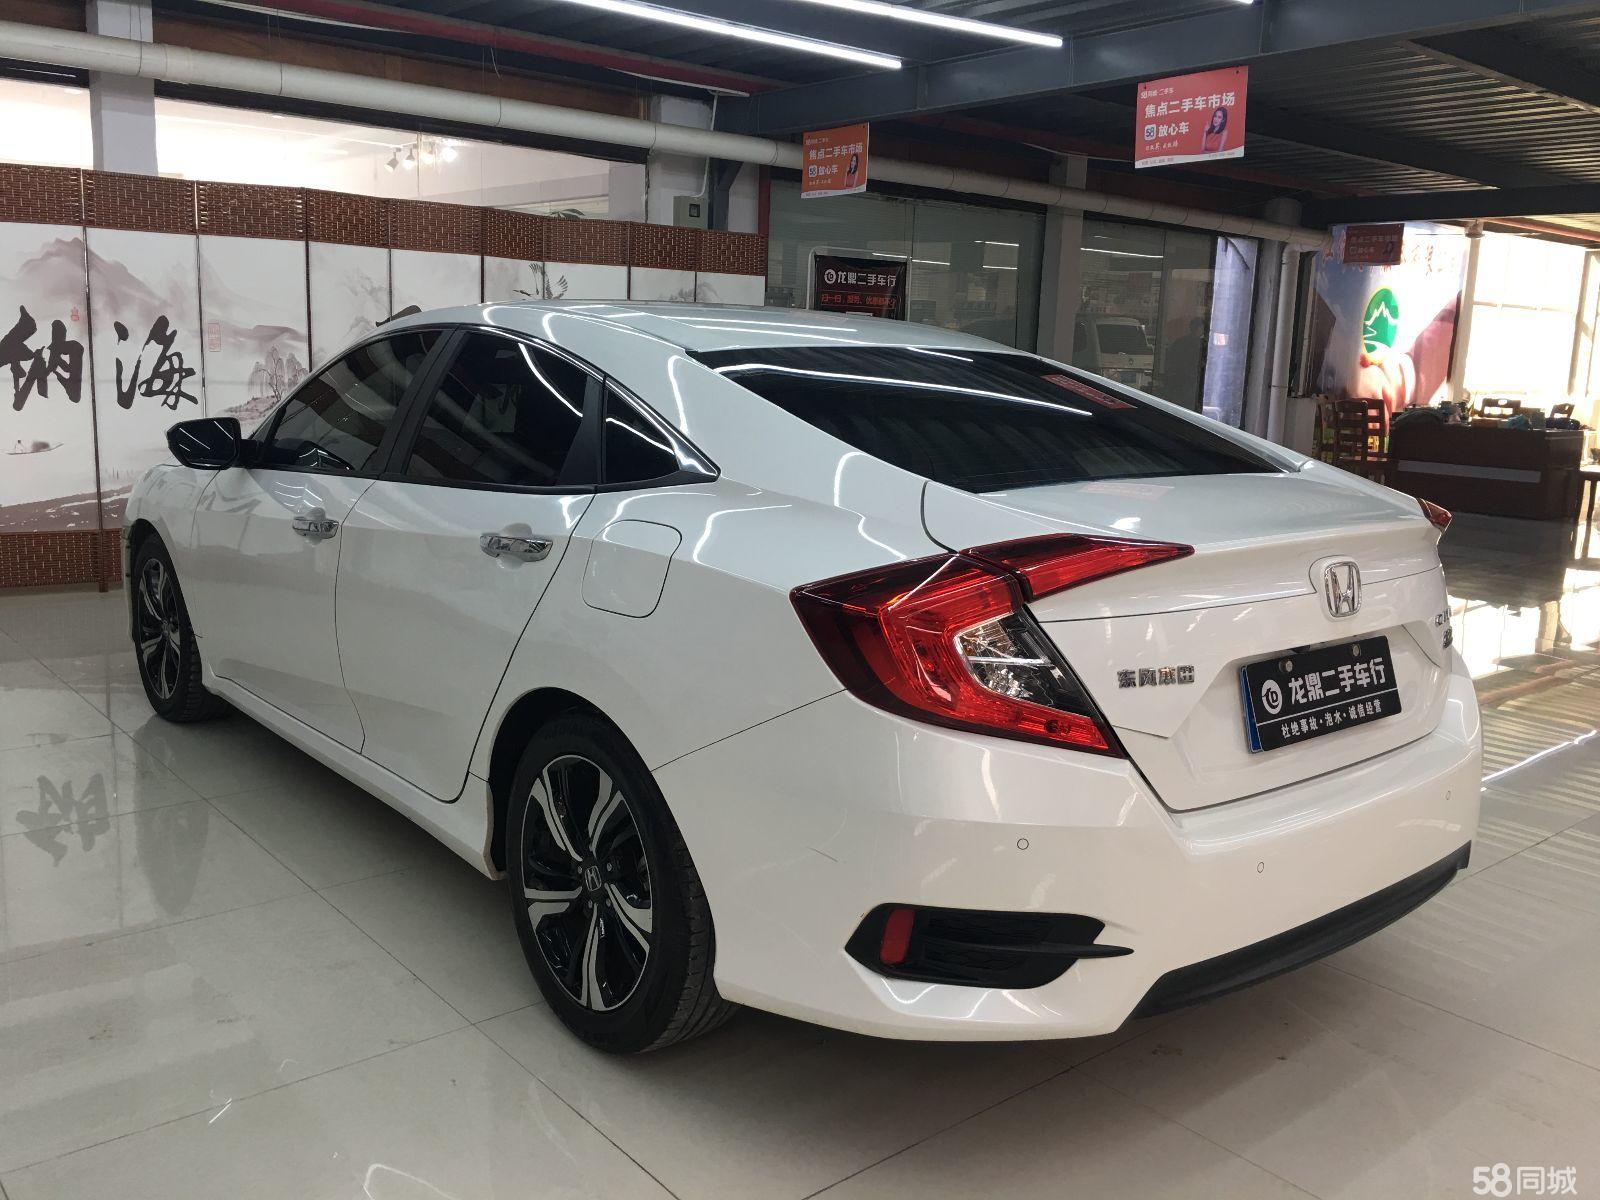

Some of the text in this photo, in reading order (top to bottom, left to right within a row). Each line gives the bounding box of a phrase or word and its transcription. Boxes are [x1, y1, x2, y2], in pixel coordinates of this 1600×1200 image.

[1144, 92, 1236, 118] 焦点二手车市场
[1158, 121, 1190, 138] 放心车
[837, 271, 897, 287] 龙鼎二手车行
[1116, 664, 1195, 689] 东风本田
[1288, 657, 1386, 705] 龙鼎二手车行
